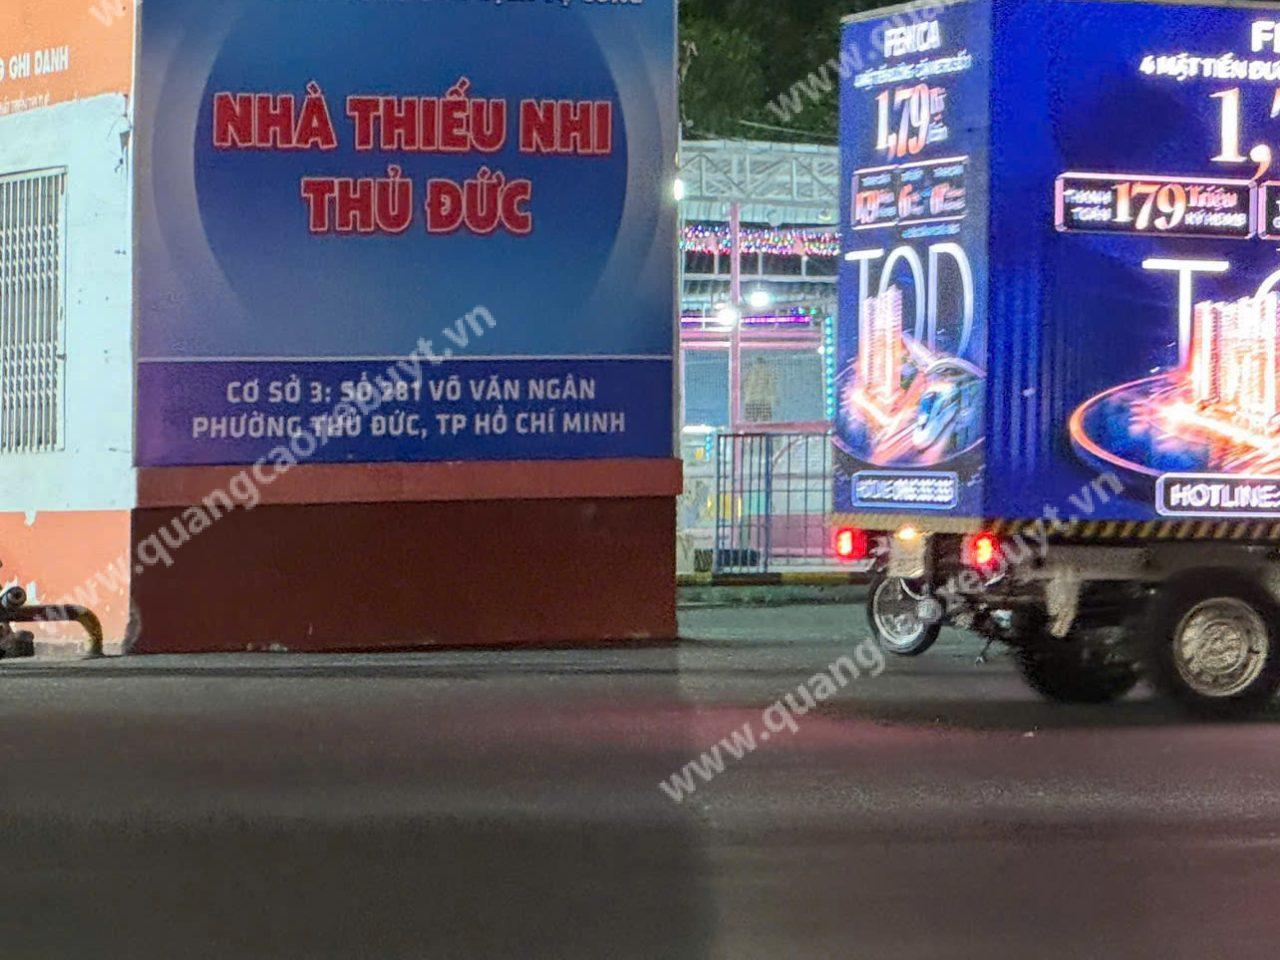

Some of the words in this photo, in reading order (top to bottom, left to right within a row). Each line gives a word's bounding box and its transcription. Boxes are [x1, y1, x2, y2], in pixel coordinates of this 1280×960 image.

[9, 52, 31, 80] GHI
[34, 44, 70, 76] DANH
[212, 80, 338, 150] NHÀ
[346, 76, 507, 152] THIẾU
[519, 99, 613, 154] NHI
[302, 164, 413, 234] THỦ
[425, 166, 533, 234] ĐỨC
[1111, 181, 1187, 230] 179
[226, 378, 260, 404] CƠ
[268, 374, 301, 404] SỞ
[310, 381, 331, 403] 3:
[428, 375, 462, 402] VÕ
[469, 375, 520, 401] VĂN
[528, 373, 596, 400] NGÂN
[192, 410, 302, 438] PHƯỜNG
[371, 409, 428, 439] ĐỨC,
[435, 413, 468, 435] TP
[474, 404, 508, 435] HỒ
[515, 407, 556, 434] CHÍ
[563, 412, 626, 434] MINH
